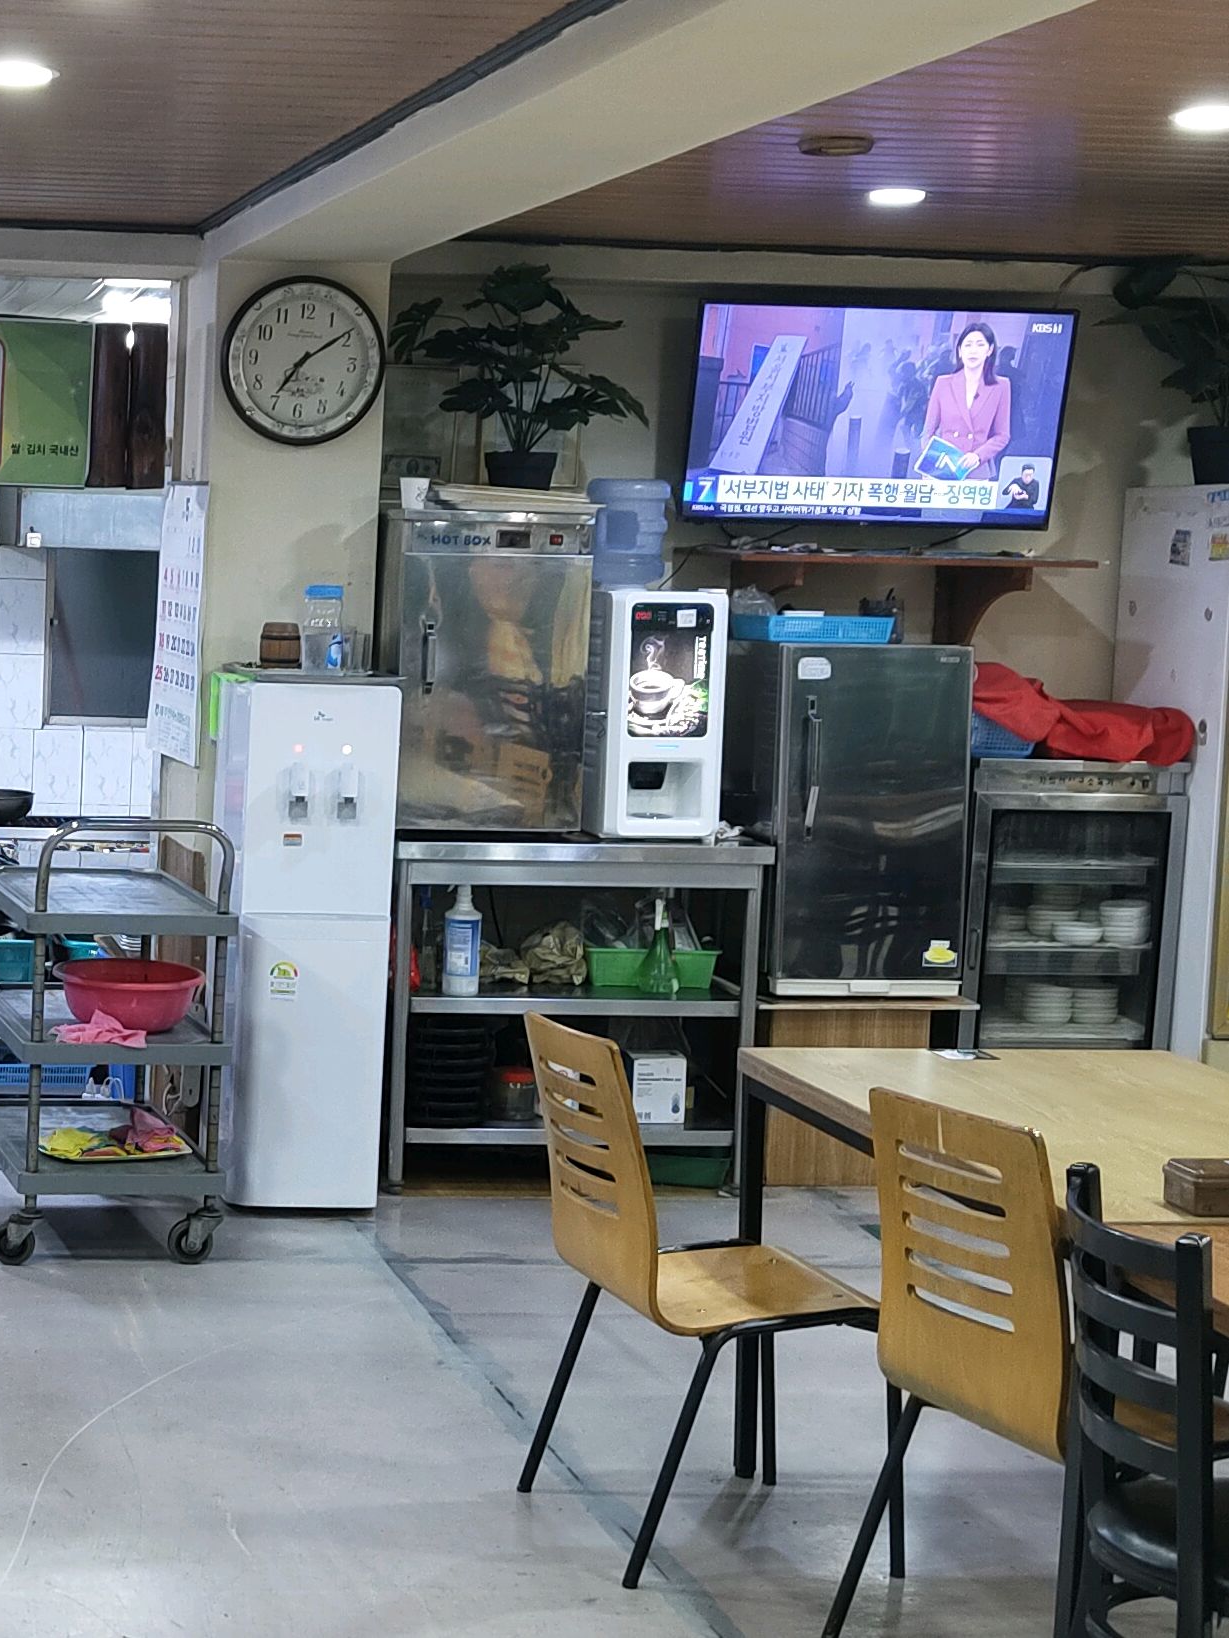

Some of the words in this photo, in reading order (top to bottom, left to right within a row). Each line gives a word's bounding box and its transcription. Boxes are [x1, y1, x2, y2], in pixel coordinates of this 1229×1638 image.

[276, 307, 289, 324] 11
[300, 303, 316, 320] 12
[329, 312, 334, 328] 1
[258, 324, 272, 342] 10
[342, 332, 352, 348] 2
[248, 348, 259, 366] 9
[346, 357, 357, 374] 3
[252, 374, 263, 390] 8
[336, 380, 344, 397] 4
[270, 395, 280, 411] 7
[292, 402, 302, 419] 6
[26, 444, 46, 456] 김치
[48, 444, 79, 457] 국내산
[832, 482, 864, 502] 기자
[430, 535, 459, 545] HOT
[463, 535, 492, 546] BOX
[155, 664, 163, 681] 25
